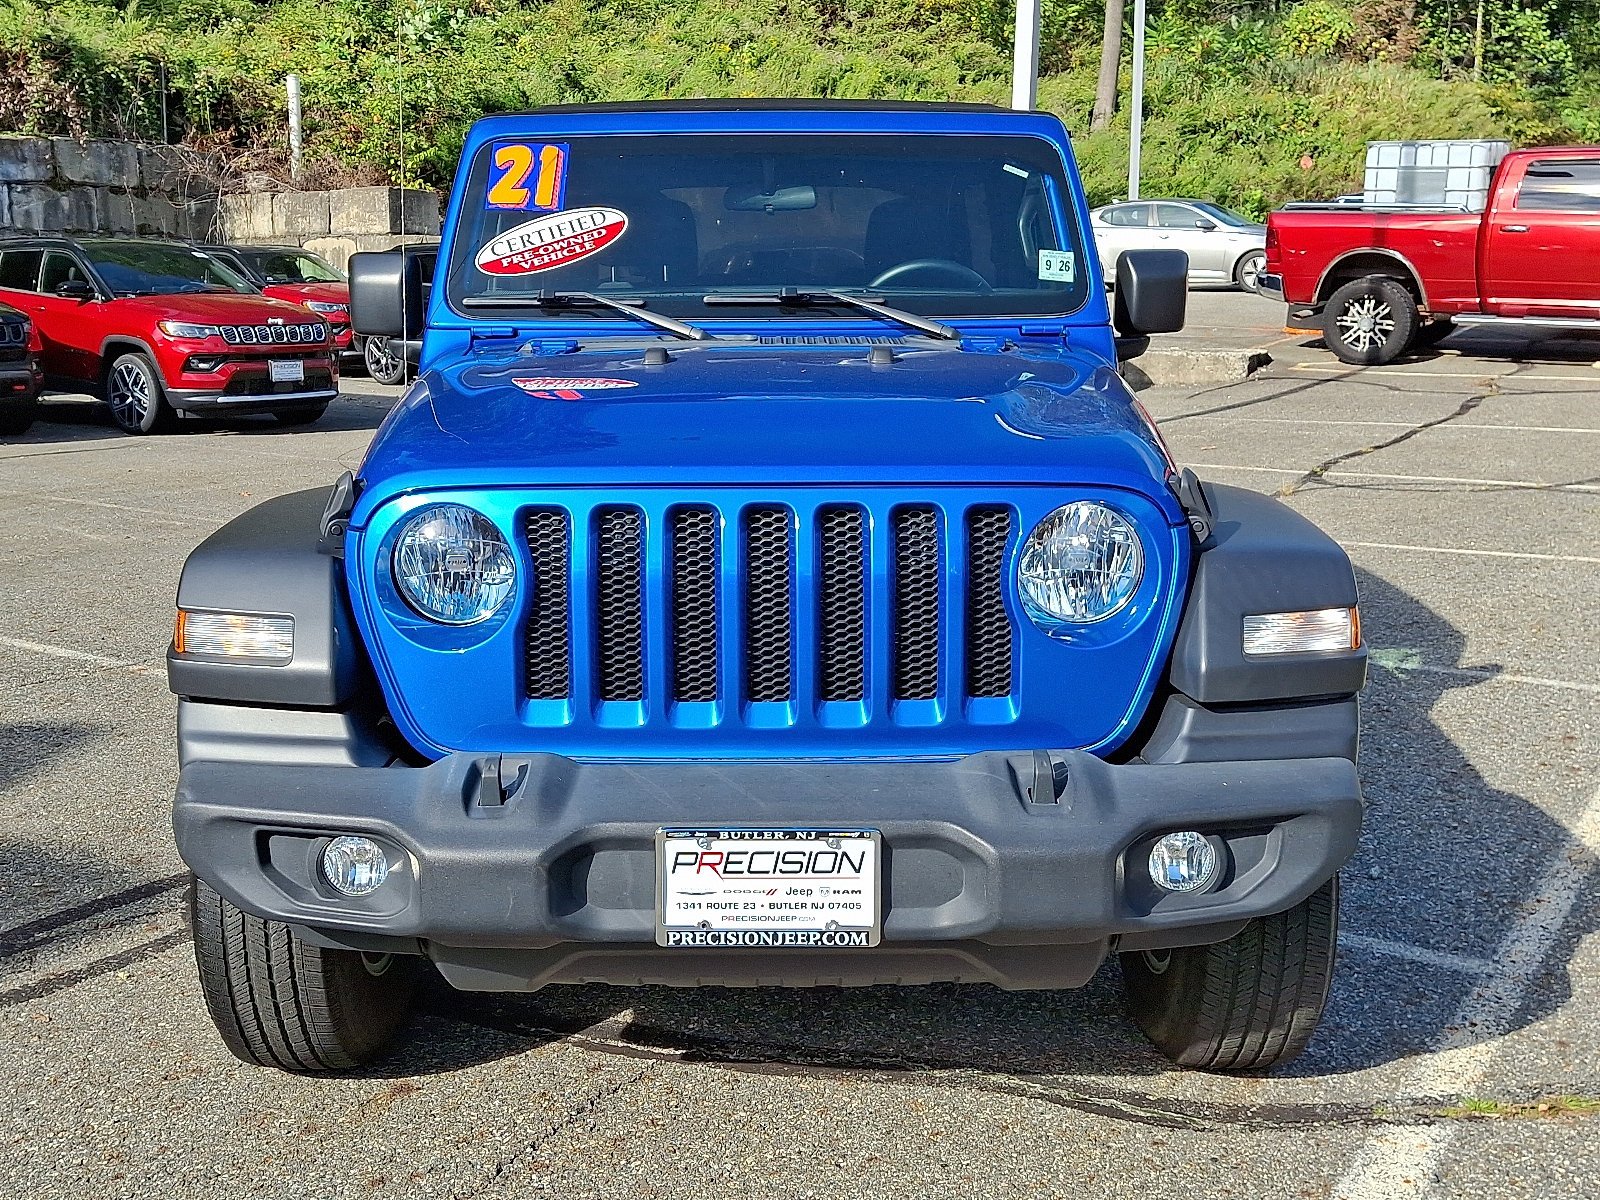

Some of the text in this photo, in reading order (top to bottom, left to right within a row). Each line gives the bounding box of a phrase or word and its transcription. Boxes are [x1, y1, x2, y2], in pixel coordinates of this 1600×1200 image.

[488, 145, 564, 208] 21
[491, 211, 607, 257] CERTIFIED
[501, 228, 607, 268] PRE-OWNED
[518, 240, 596, 270] VEHICLE
[1045, 259, 1071, 272] 9 26
[719, 831, 817, 840] BUTLER, NJ
[671, 850, 866, 877] PRECISION
[785, 886, 813, 897] Jeep
[676, 902, 862, 910] 1341 ROUTE 23 BUTLER NJ 07405
[667, 931, 869, 946] PRECISIONJEEP.COM
